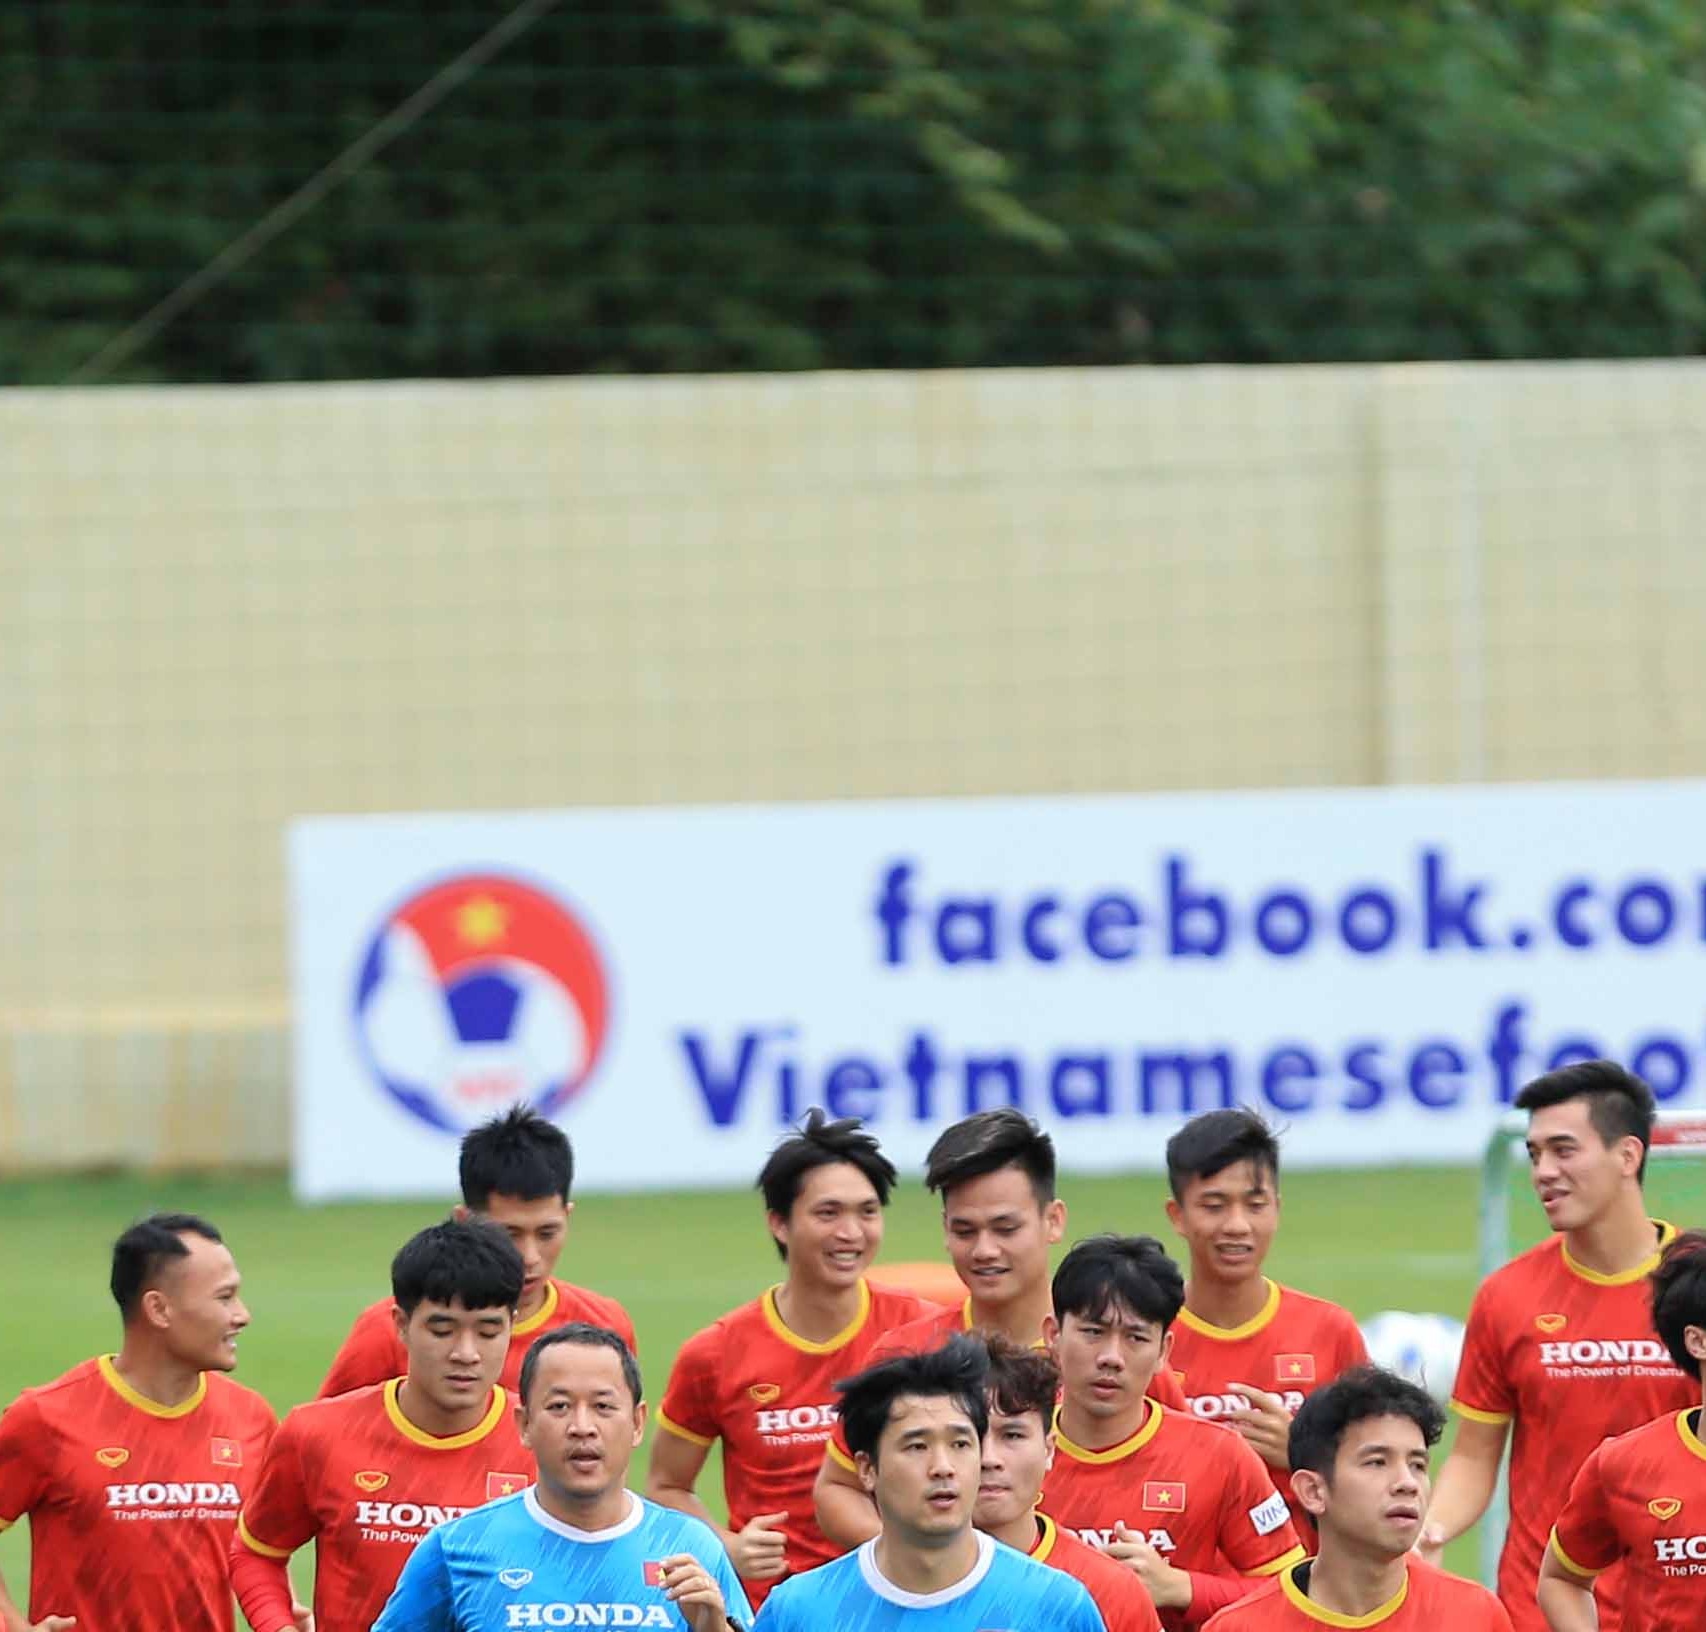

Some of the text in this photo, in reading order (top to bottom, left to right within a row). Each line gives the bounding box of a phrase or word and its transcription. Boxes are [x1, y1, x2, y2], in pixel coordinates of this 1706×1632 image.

[1546, 1366, 1572, 1378] The
[1573, 1365, 1615, 1377] Power
[1617, 1364, 1632, 1376] of
[106, 1483, 241, 1507] HONDA
[141, 1508, 179, 1520] Power
[361, 1528, 388, 1542] The
[1662, 1564, 1687, 1577] The
[506, 1603, 673, 1630] HONDA
